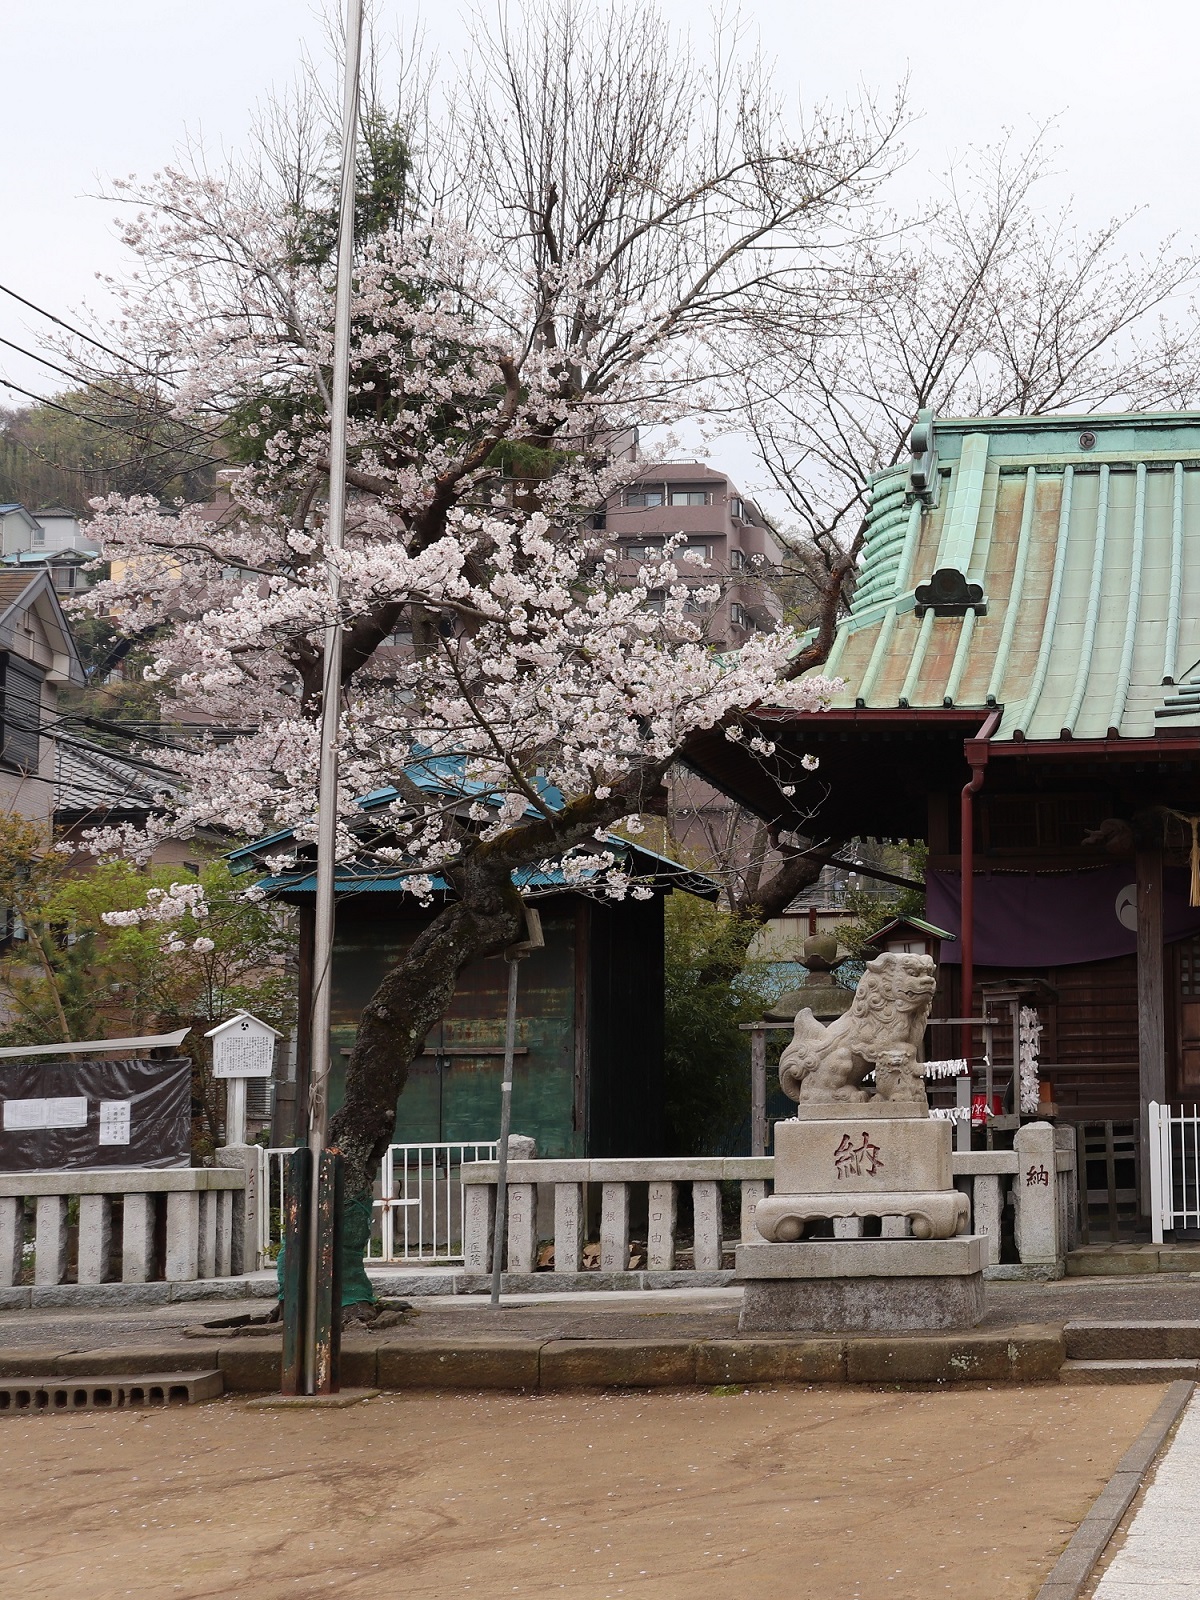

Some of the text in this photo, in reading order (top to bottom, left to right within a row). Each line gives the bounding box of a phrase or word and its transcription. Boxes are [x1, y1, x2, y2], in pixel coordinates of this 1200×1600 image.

[834, 1131, 884, 1180] 納
[1026, 1163, 1050, 1188] 納
[651, 1189, 663, 1265] 山口由松
